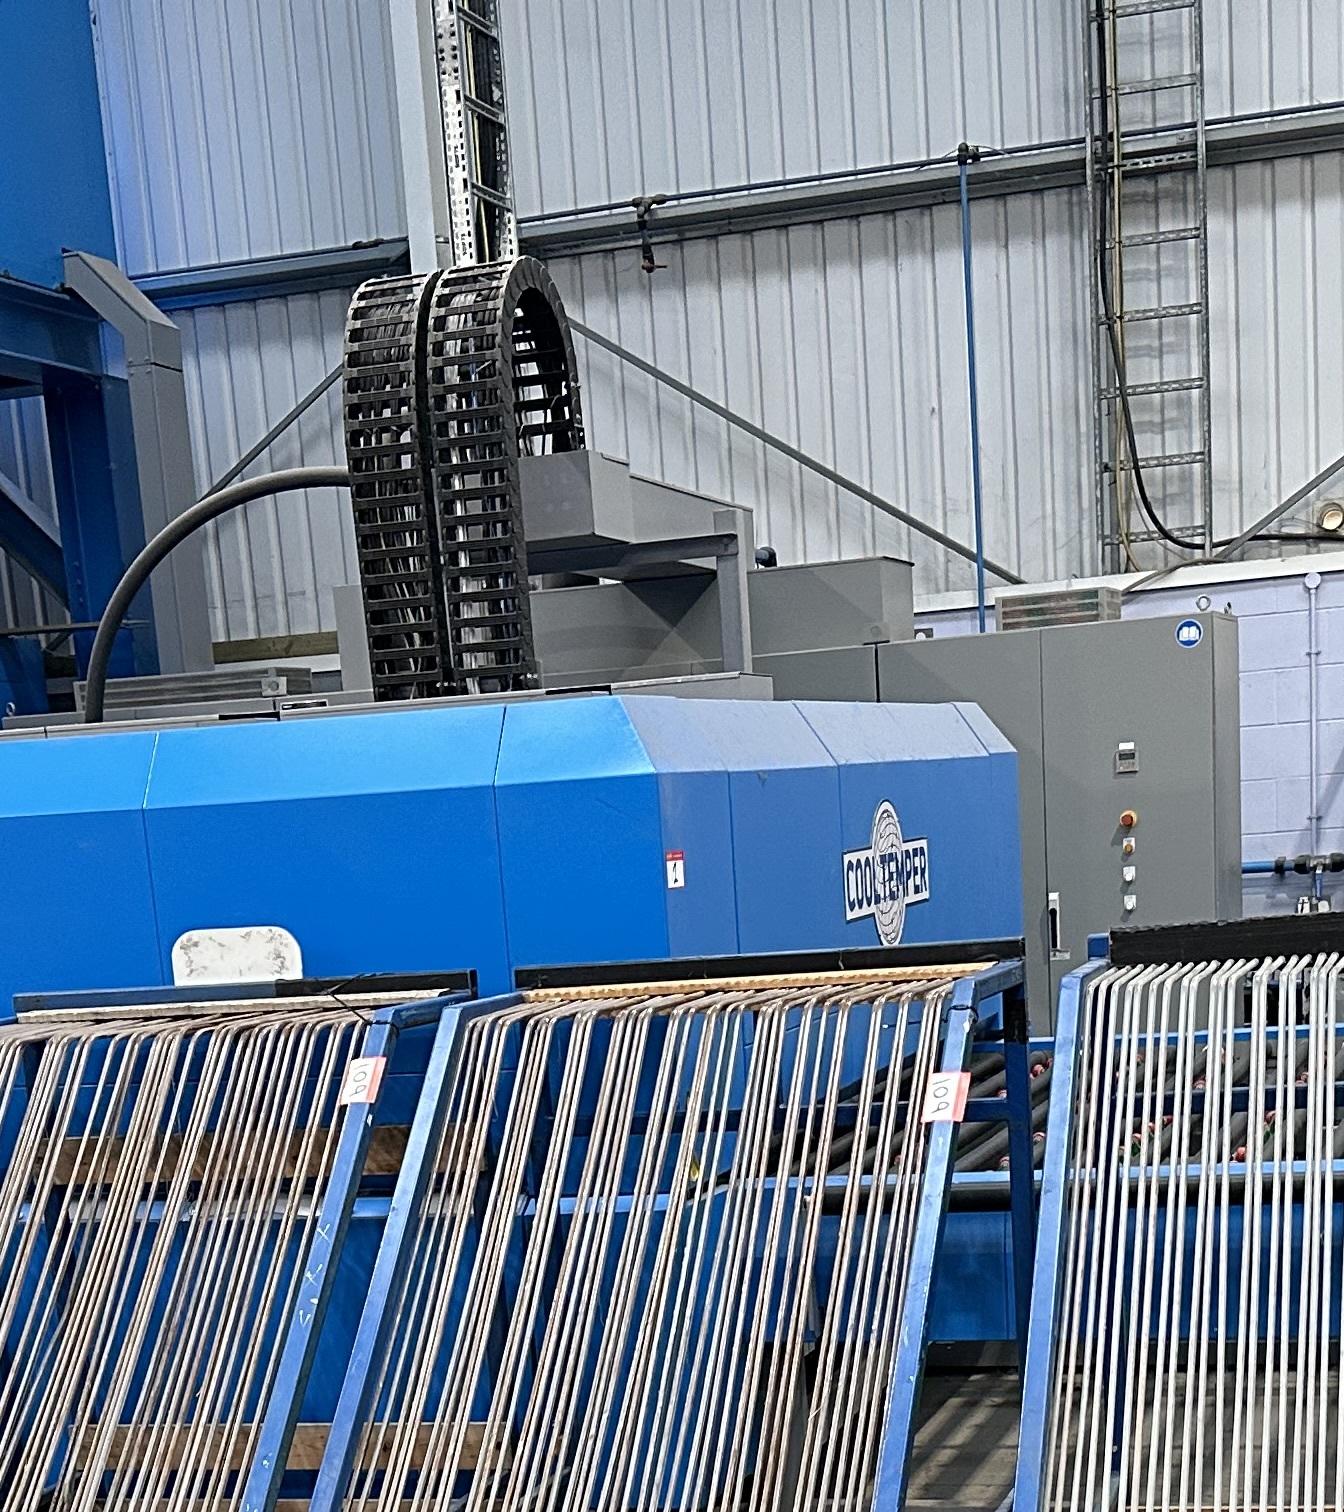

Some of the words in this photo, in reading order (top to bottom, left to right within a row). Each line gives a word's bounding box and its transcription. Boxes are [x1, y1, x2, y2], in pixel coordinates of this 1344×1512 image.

[846, 846, 928, 912] COOLTEMPER
[348, 1063, 370, 1097] 109
[931, 1078, 952, 1114] 109
